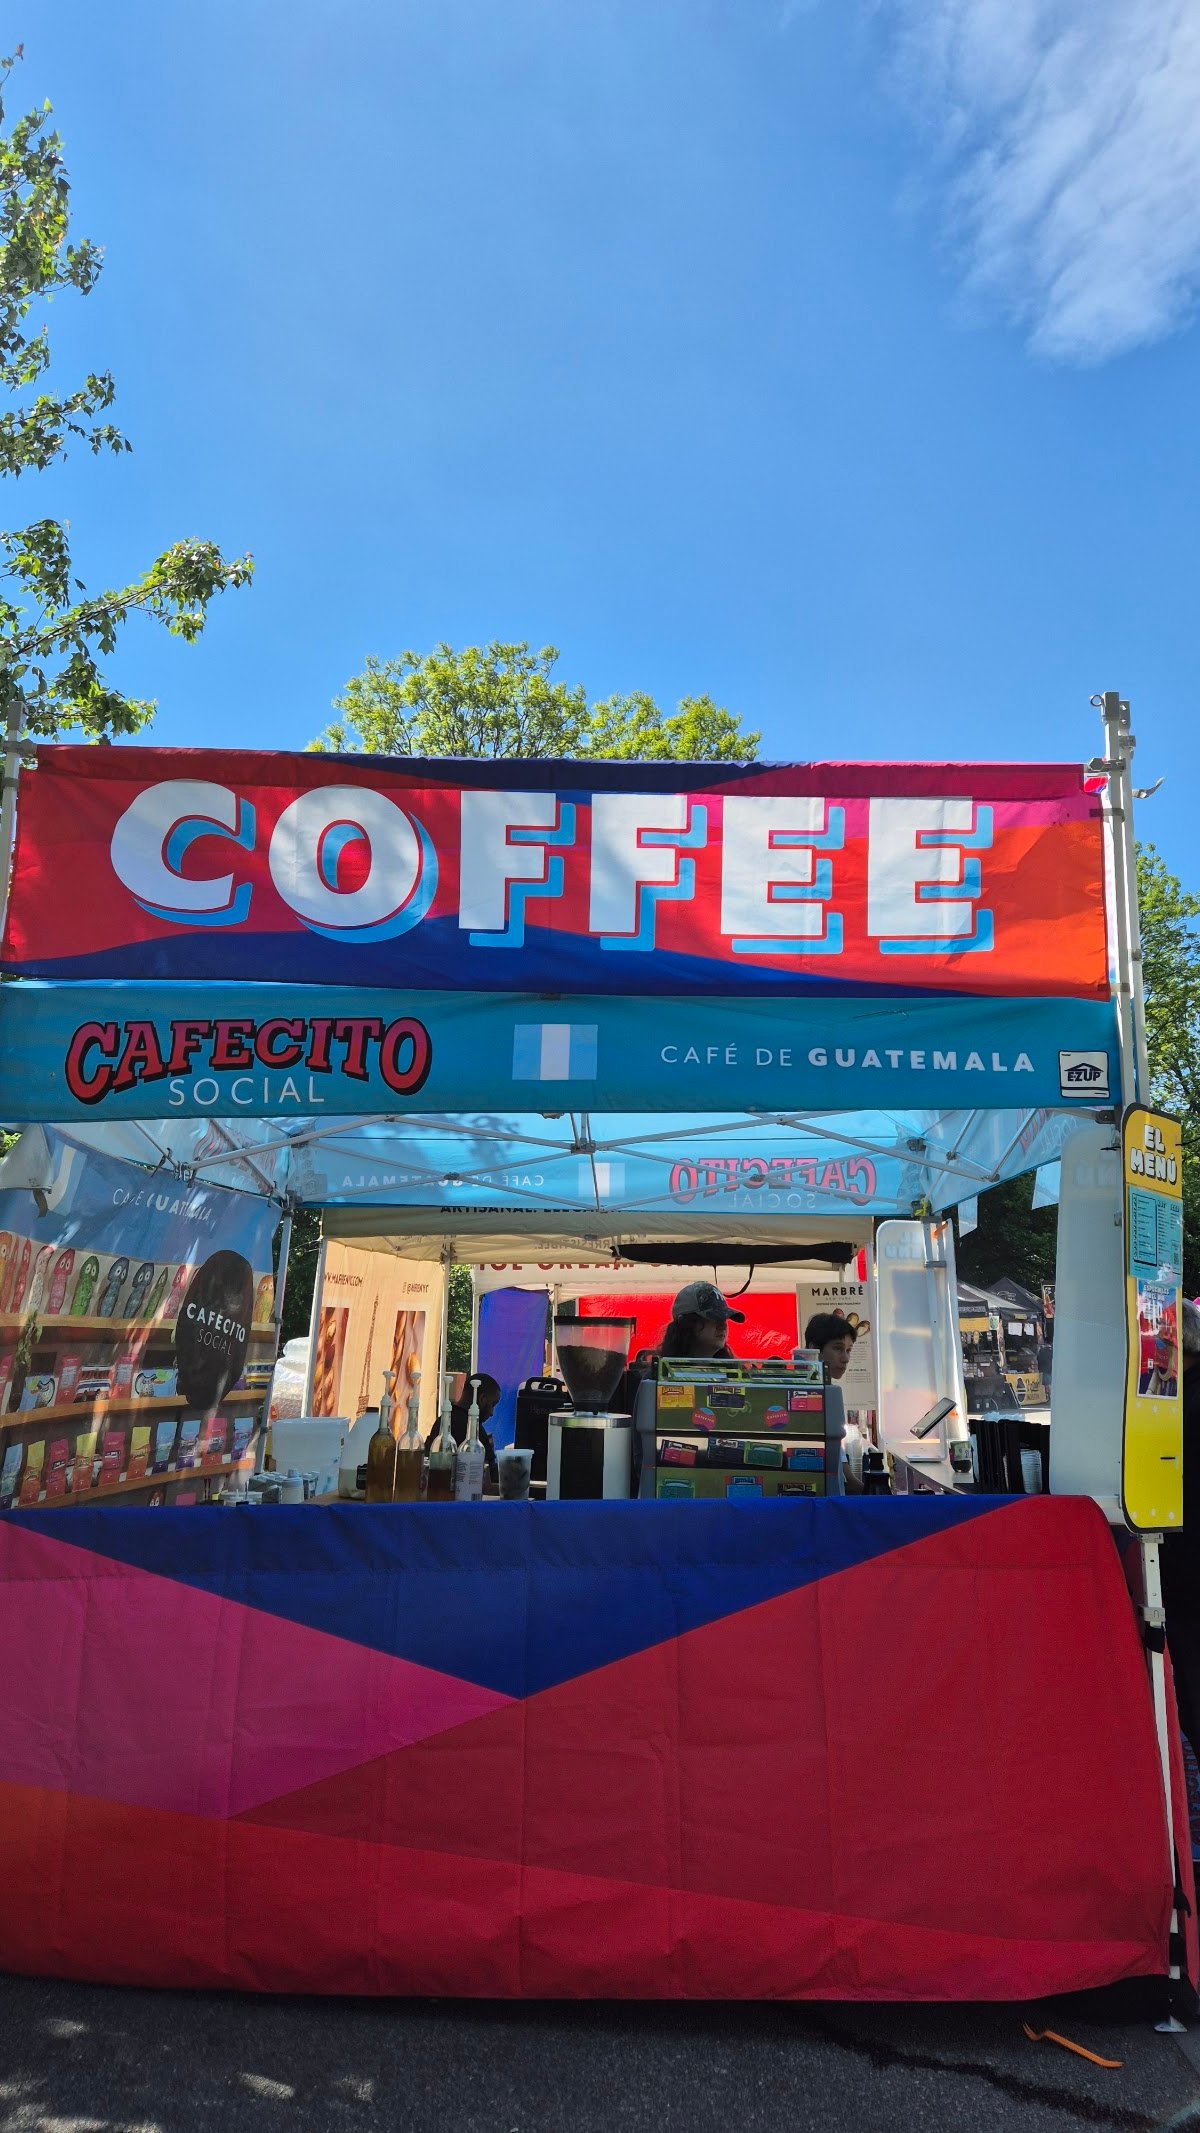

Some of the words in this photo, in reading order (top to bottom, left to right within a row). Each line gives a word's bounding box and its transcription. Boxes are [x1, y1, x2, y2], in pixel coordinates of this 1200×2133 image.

[110, 779, 995, 955] COFFEE
[65, 1016, 432, 1105] CAFECITO
[660, 1042, 738, 1064] CAFÉ
[756, 1048, 793, 1067] DE
[808, 1047, 1035, 1072] GUATEMALA
[168, 1076, 325, 1106] SOCIAL
[1144, 1124, 1165, 1154] EL
[1130, 1146, 1177, 1185] MENÚ
[811, 1285, 864, 1296] MARBRÉ
[186, 1303, 246, 1343] CAFECITO
[197, 1328, 232, 1355] SOCIAL
